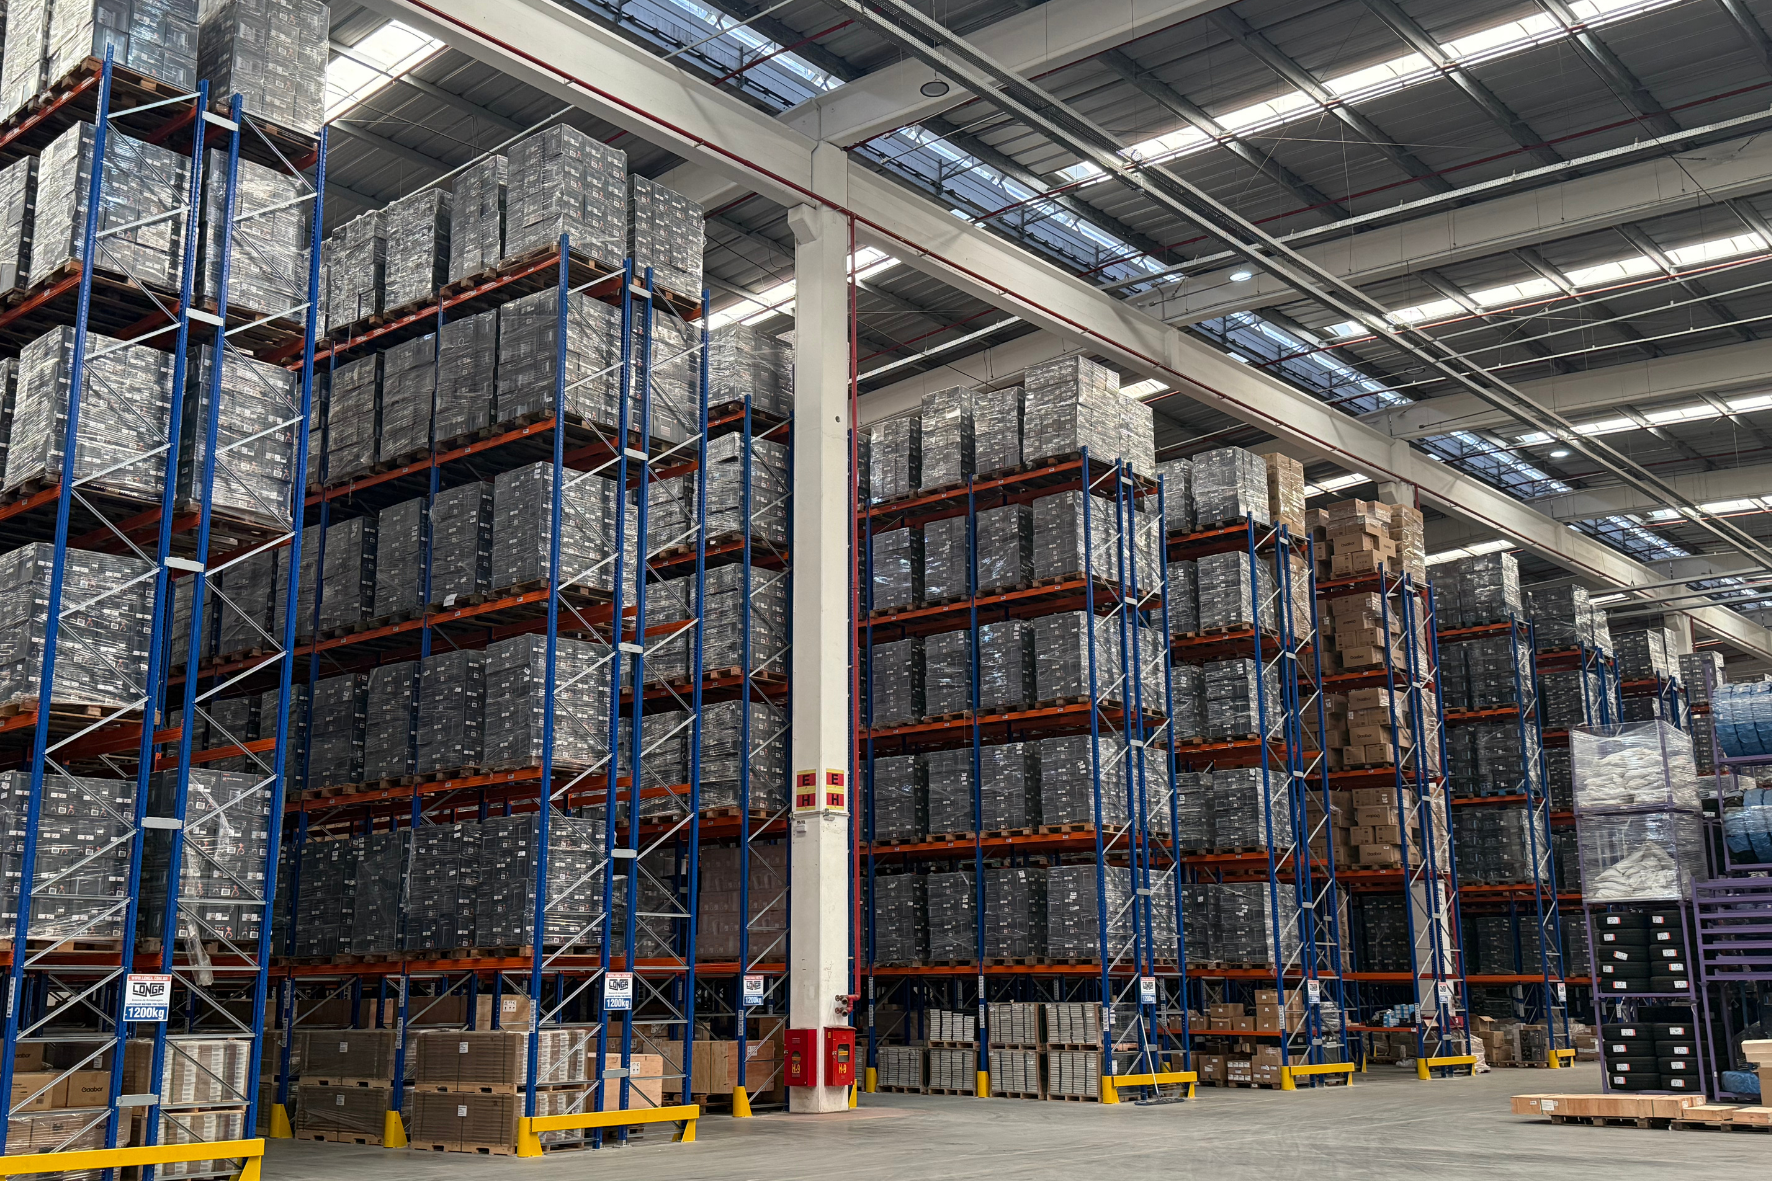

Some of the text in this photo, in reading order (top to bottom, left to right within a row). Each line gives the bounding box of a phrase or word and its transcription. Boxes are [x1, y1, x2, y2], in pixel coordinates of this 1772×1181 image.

[803, 775, 810, 786] E
[832, 774, 838, 785] E
[802, 795, 810, 806] H
[832, 795, 839, 806] H
[133, 983, 165, 997] LONGA
[609, 979, 628, 991] LONGA
[607, 999, 630, 1009] 1200kg
[128, 1007, 165, 1020] 1200kg
